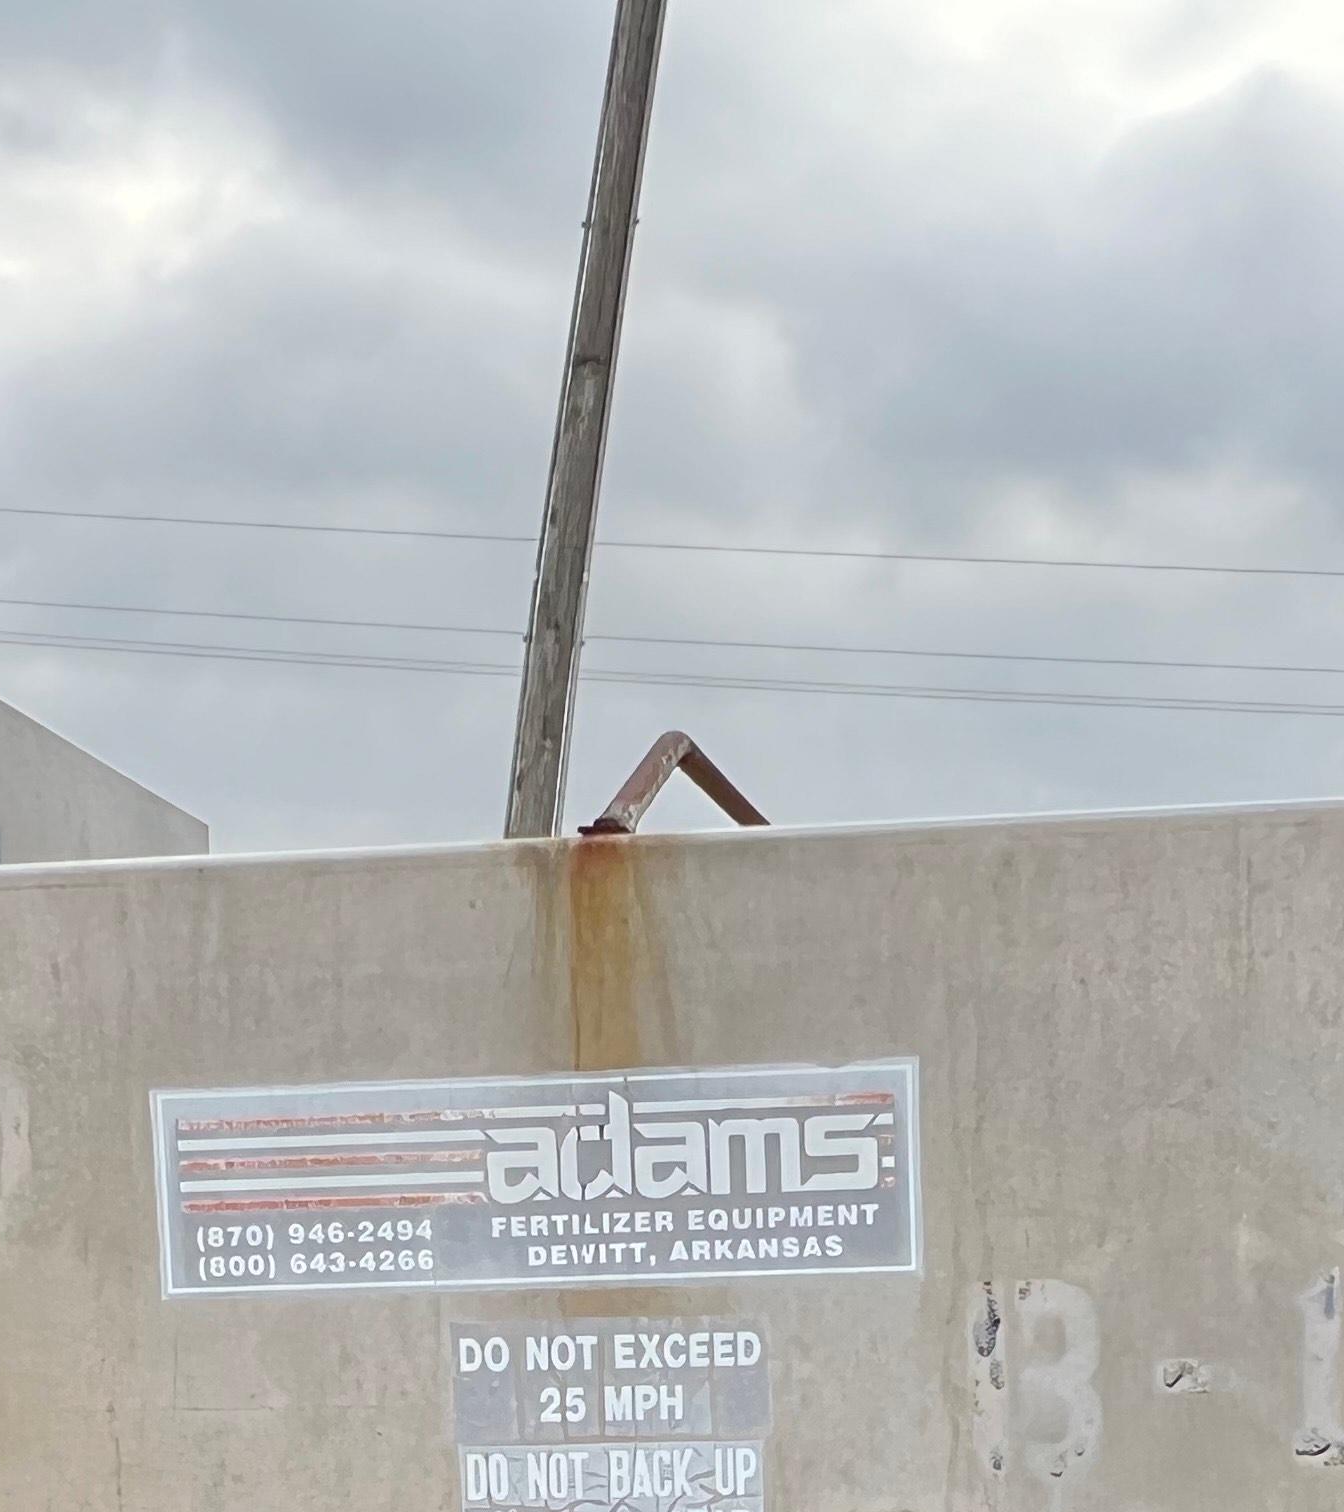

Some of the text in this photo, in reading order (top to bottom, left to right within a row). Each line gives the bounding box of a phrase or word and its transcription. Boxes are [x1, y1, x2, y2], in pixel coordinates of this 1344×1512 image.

[486, 1090, 879, 1204] adams
[196, 1218, 433, 1253] (870) 946-2494
[491, 1203, 879, 1239] FERTILIZER EQUIPMENT
[198, 1249, 434, 1281] (800) 643-4266
[527, 1235, 844, 1267] DEWITT, ARKANSAS
[458, 1331, 762, 1373] DO NOT EXCEED
[539, 1384, 684, 1423] 25 MPH
[464, 1447, 756, 1501] DO NOT BACK UP
